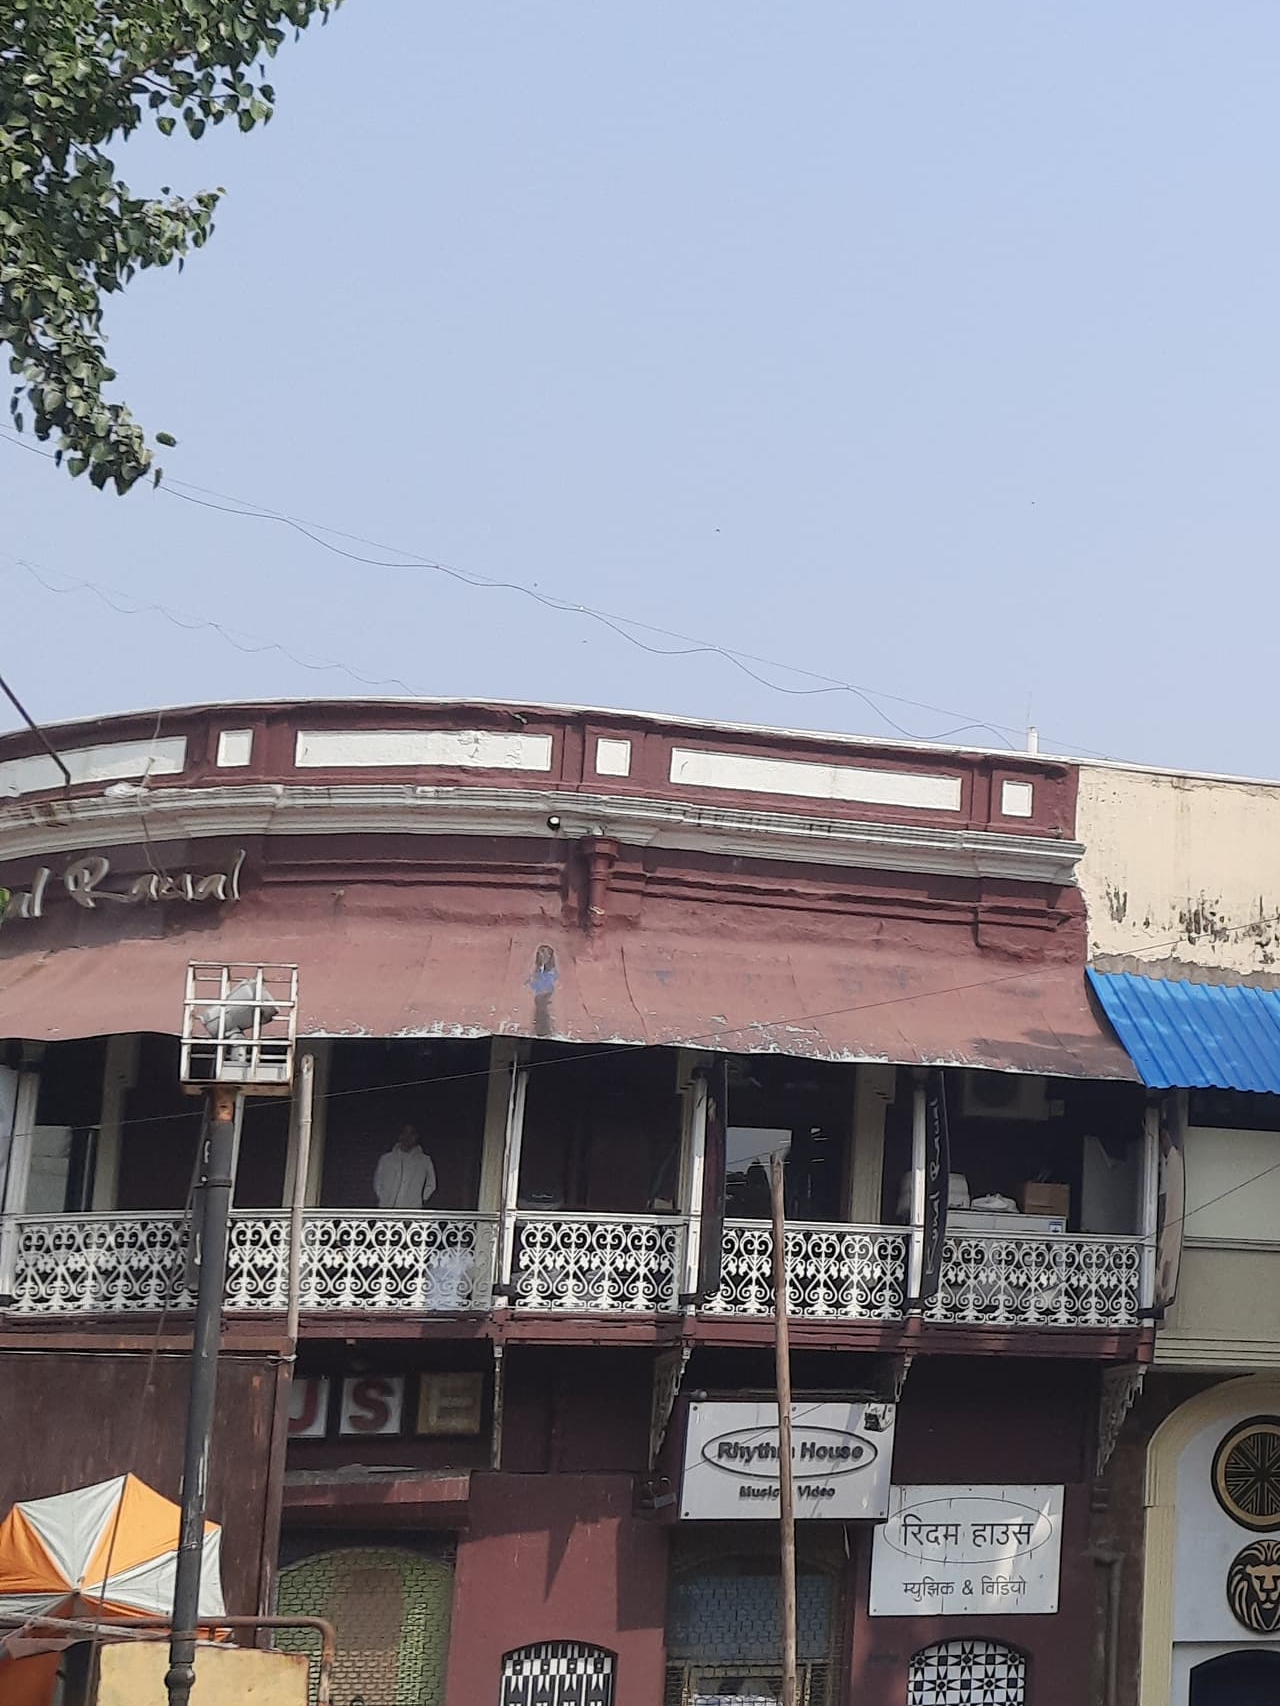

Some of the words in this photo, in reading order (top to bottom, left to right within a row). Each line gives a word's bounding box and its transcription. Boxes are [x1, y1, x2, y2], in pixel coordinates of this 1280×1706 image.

[717, 1442, 795, 1464] Rhyth
[801, 1443, 864, 1461] House
[739, 1485, 780, 1499] Music
[797, 1485, 836, 1499] Video
[901, 1513, 962, 1546] रिदम
[970, 1523, 1034, 1548] हाउस
[902, 1575, 955, 1602] म्युझिक
[961, 1579, 974, 1596] &
[981, 1575, 1027, 1596] विडियो
